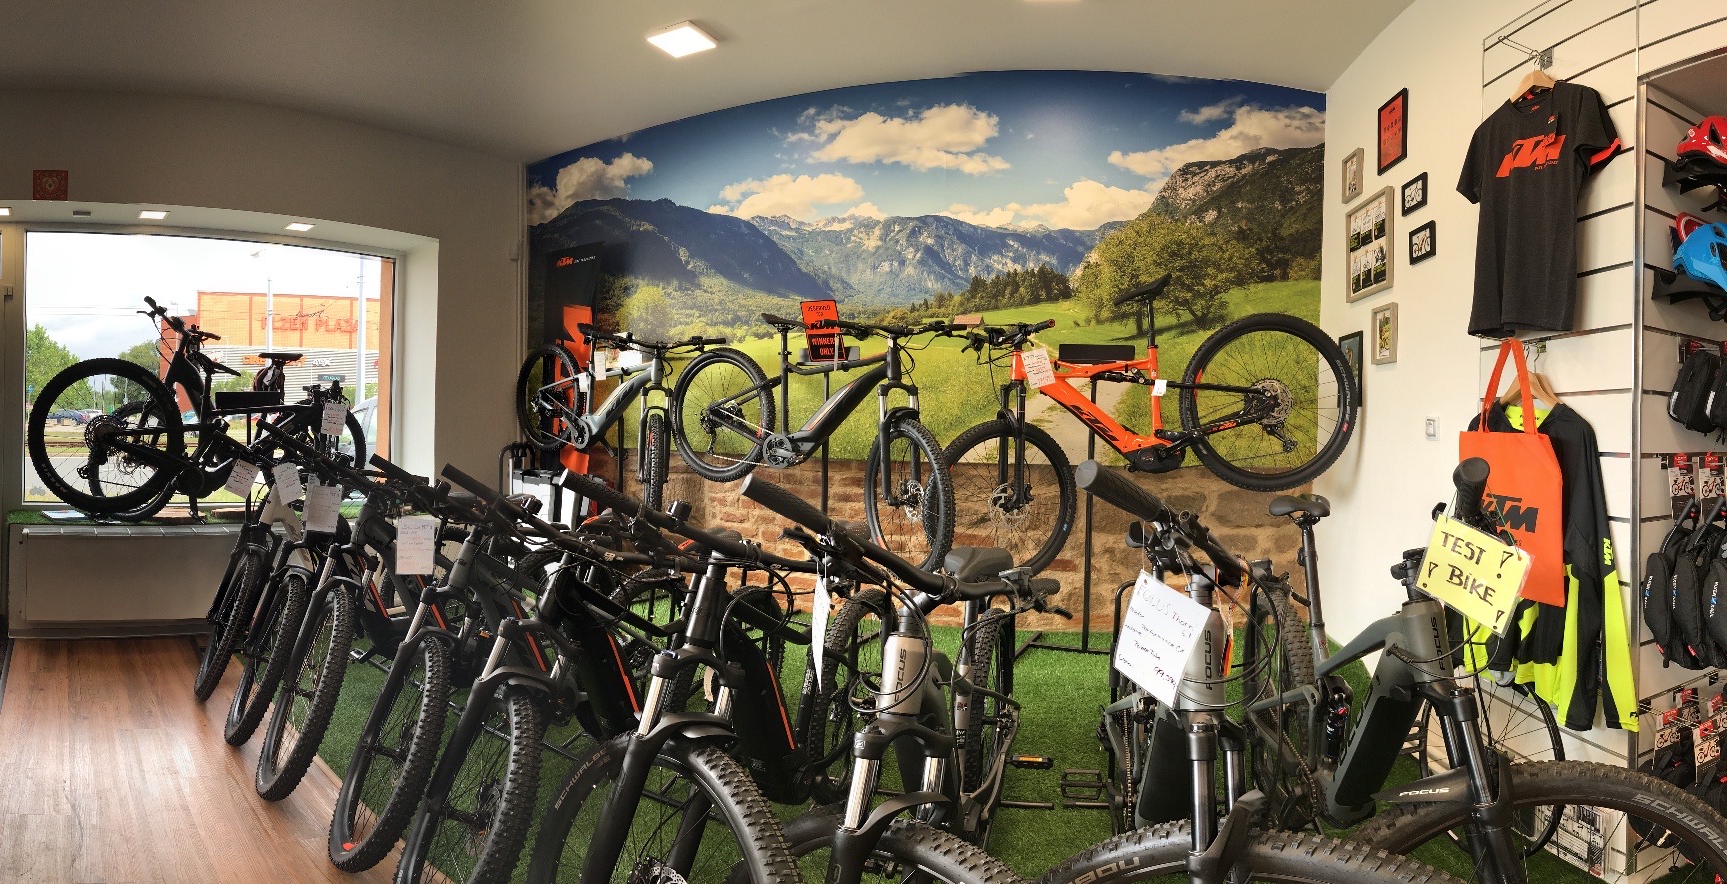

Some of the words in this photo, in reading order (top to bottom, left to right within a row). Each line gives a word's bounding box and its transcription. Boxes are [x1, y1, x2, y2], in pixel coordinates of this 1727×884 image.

[1496, 134, 1566, 178] KTM
[1441, 531, 1487, 566] TEST
[1603, 537, 1615, 566] KTM
[1204, 629, 1213, 691] FOCUS
[1430, 616, 1446, 671] FOCUS
[1399, 787, 1450, 797] FOCUS
